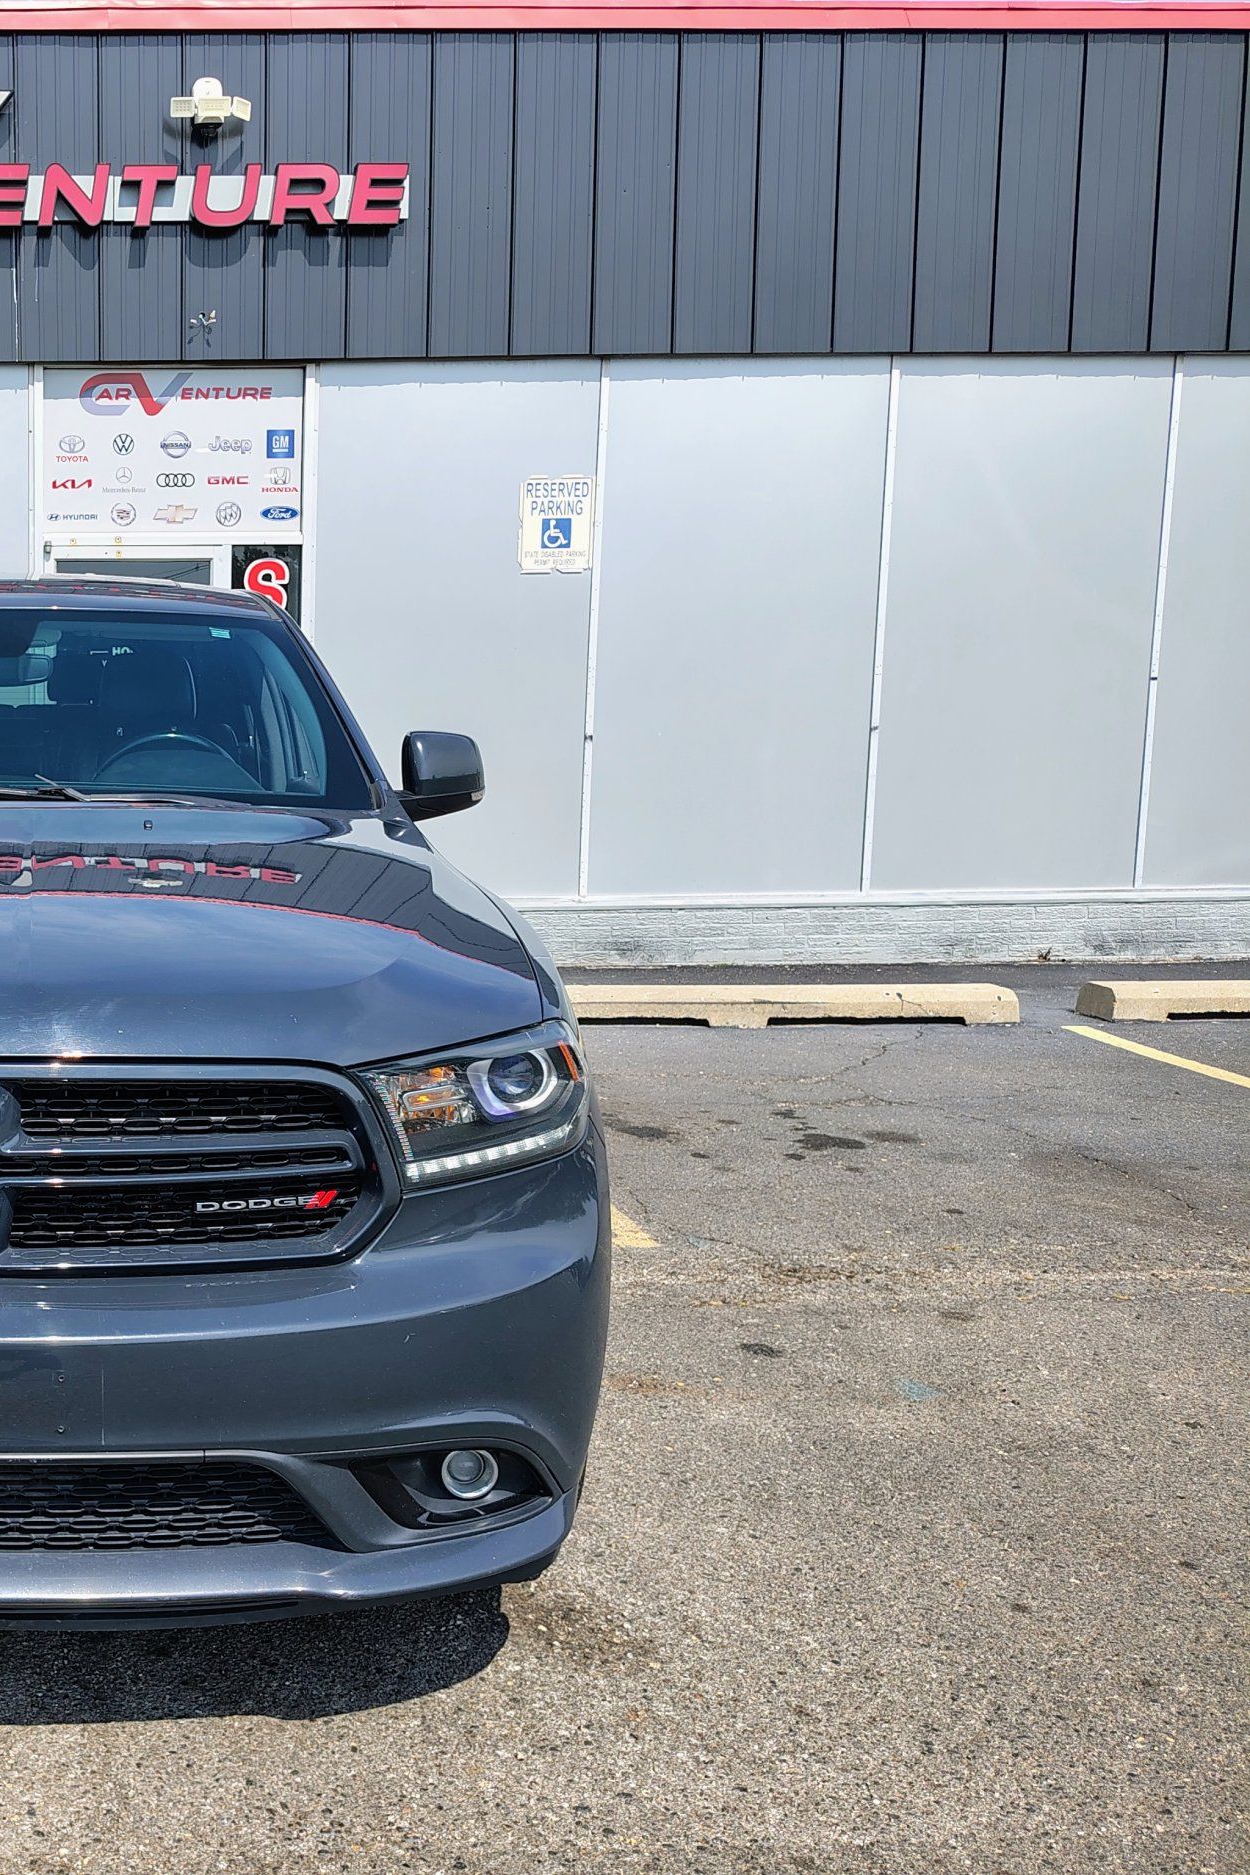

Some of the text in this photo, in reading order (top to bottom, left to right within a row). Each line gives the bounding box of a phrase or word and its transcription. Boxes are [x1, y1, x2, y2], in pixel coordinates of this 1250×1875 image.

[161, 441, 190, 449] NISSAN
[208, 435, 253, 455] Jeep
[272, 436, 290, 448] GM
[56, 455, 89, 463] TOYOTA
[52, 479, 92, 490] KIA
[207, 476, 249, 485] GMC
[526, 482, 590, 499] RESERVED
[530, 499, 584, 516] PARKING
[268, 508, 292, 519] Ford
[196, 1194, 320, 1212] DODGE
